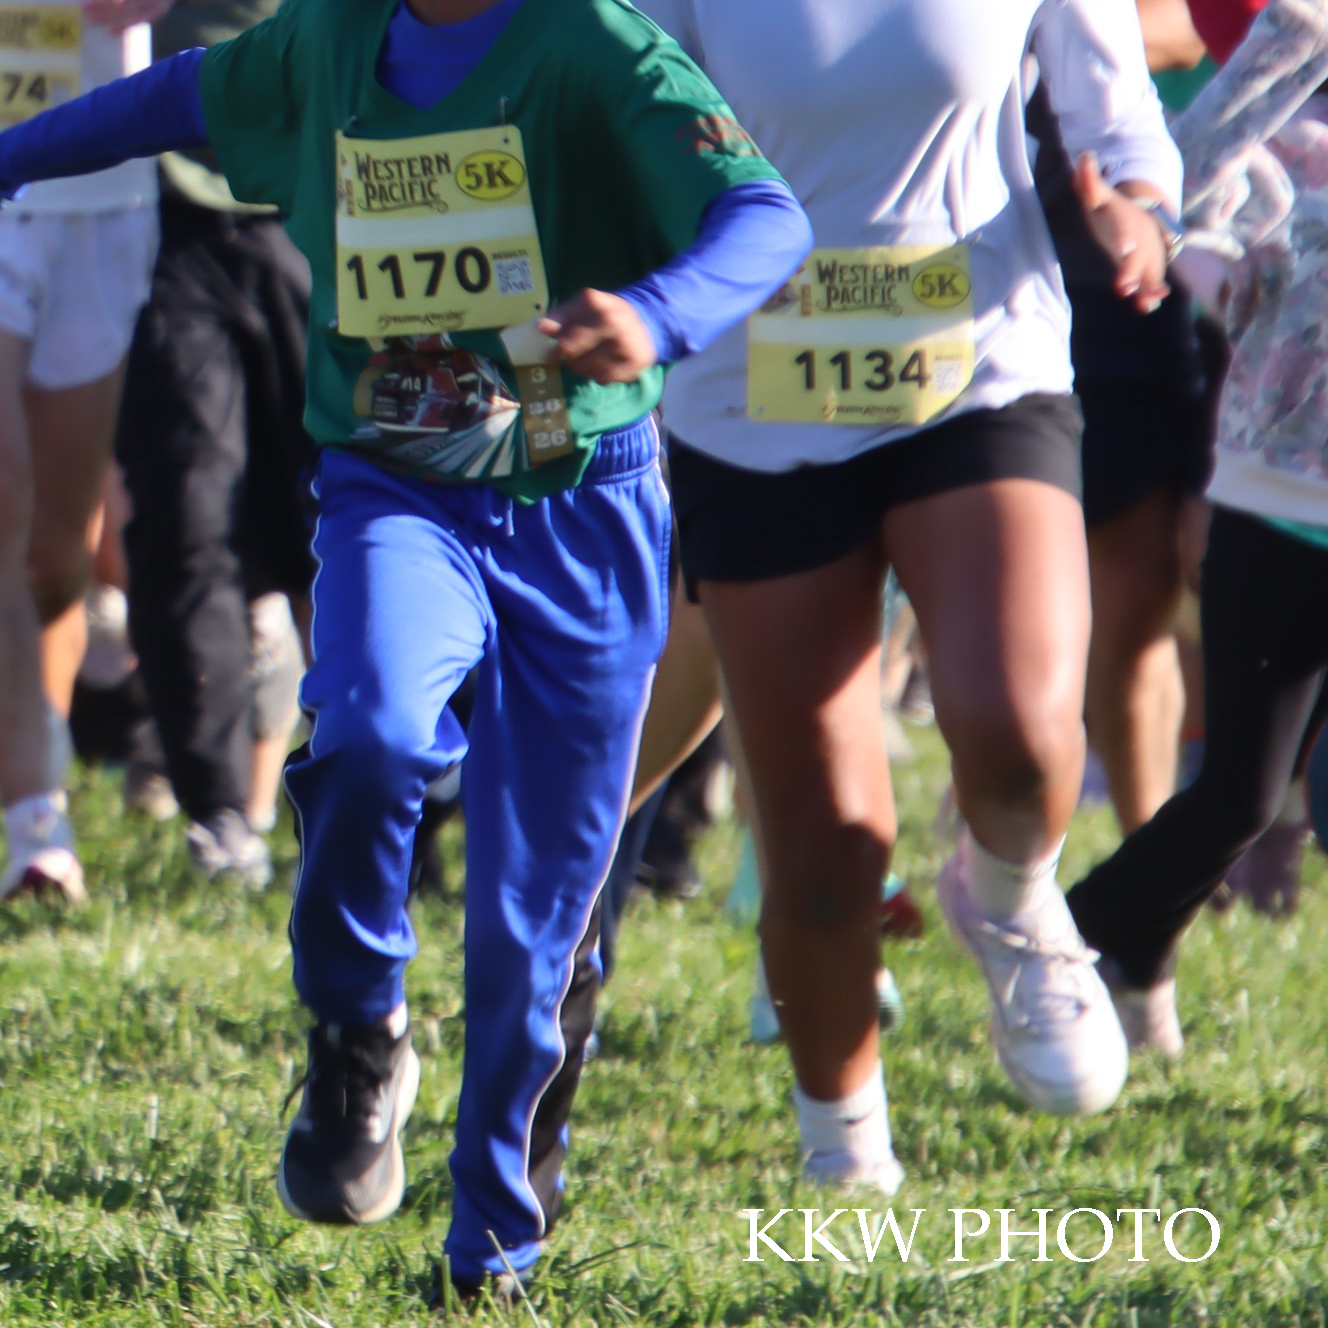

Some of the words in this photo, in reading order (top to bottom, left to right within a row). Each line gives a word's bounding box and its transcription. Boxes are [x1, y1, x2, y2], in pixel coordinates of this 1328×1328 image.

[354, 152, 453, 181] WESTERN
[465, 162, 515, 190] 5K
[364, 178, 440, 208] PACIFIC
[346, 247, 491, 300] 1170
[816, 259, 910, 284] WESTERN
[919, 273, 963, 299] 5K
[826, 284, 897, 309] PACIFIC
[794, 349, 932, 392] 1134
